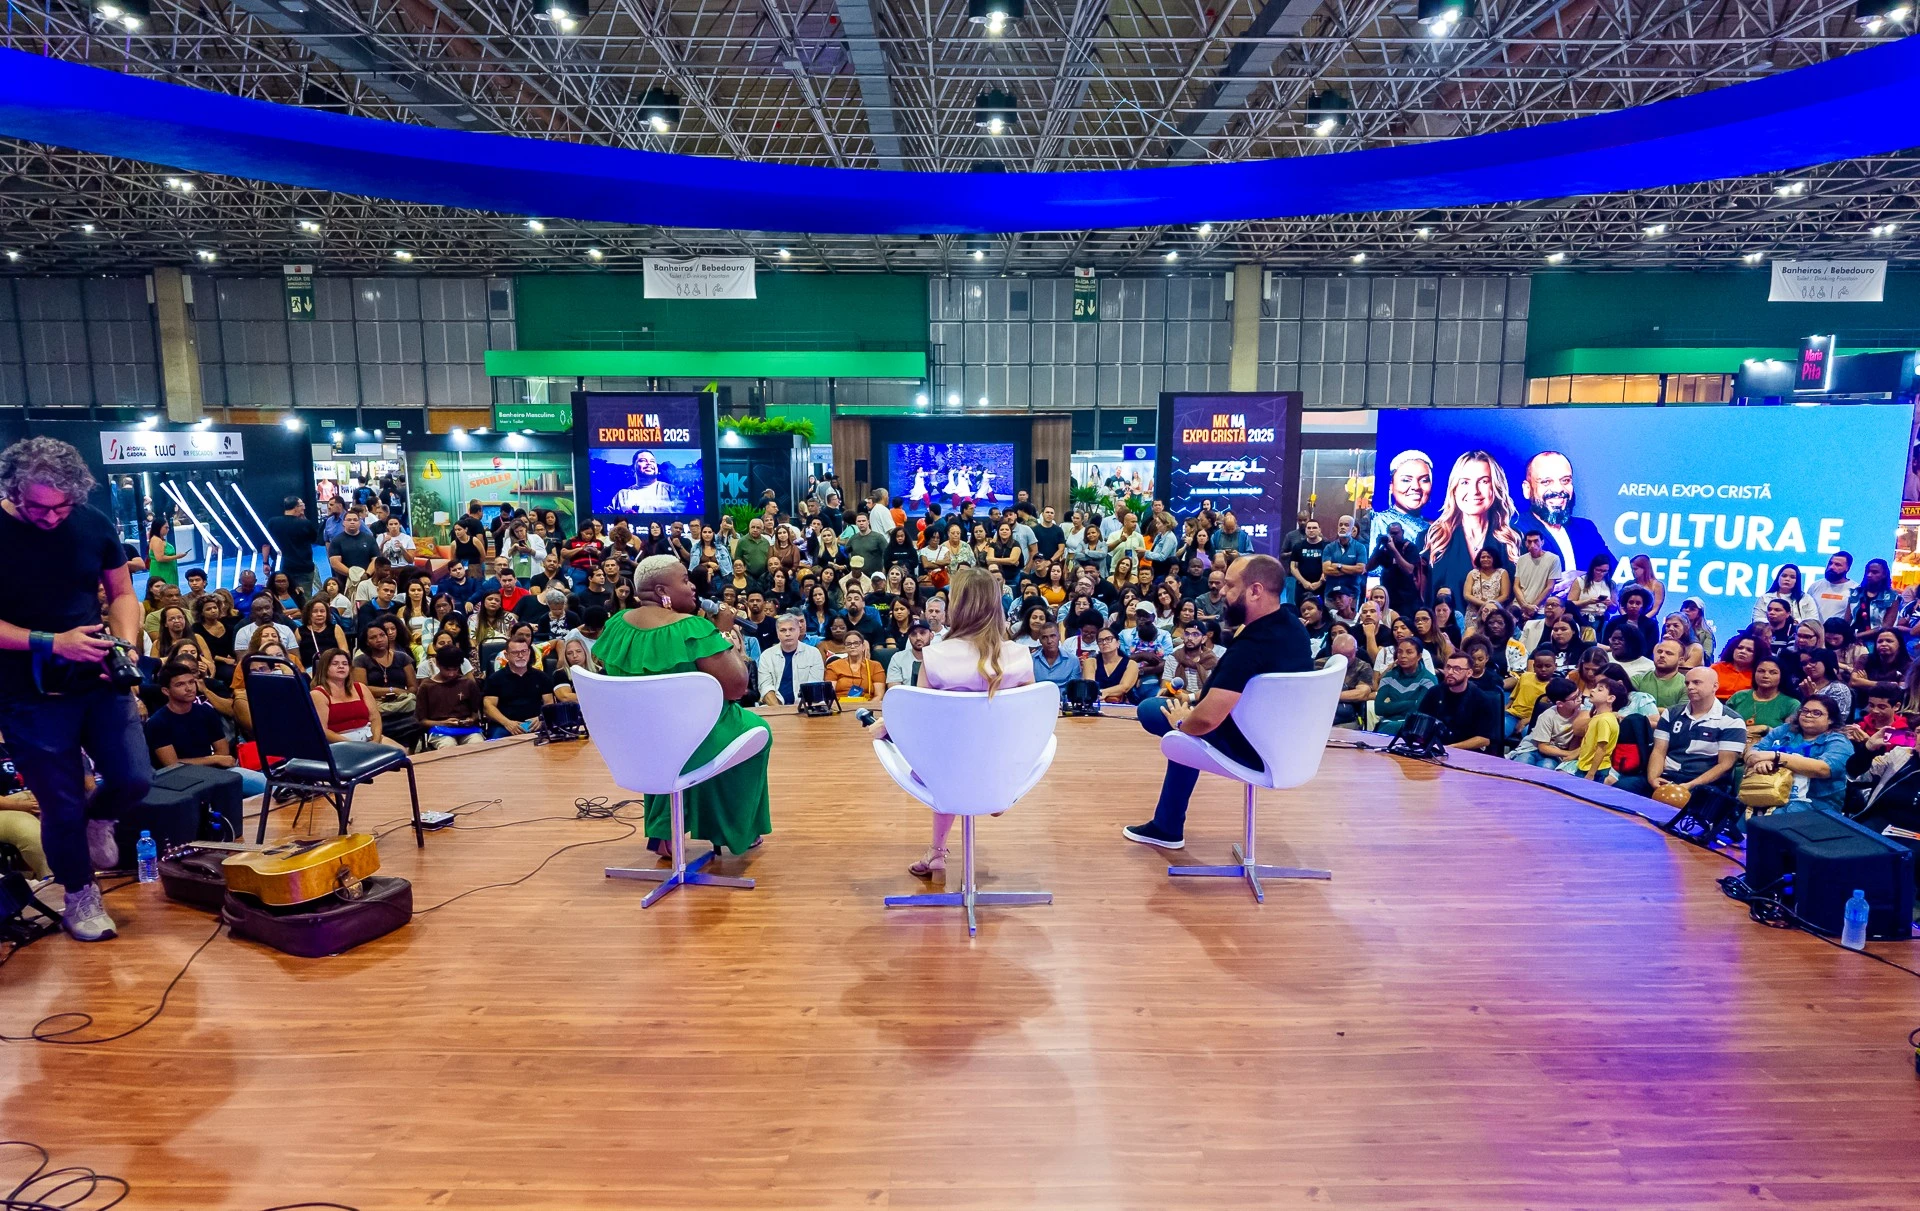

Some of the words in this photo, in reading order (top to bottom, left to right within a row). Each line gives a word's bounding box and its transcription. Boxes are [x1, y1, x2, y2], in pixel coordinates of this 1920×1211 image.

[654, 264, 693, 272] Banheiros
[1805, 349, 1822, 362] Maria
[1802, 362, 1822, 380] Pita
[628, 414, 644, 427] MK
[645, 414, 660, 427] NA
[1213, 414, 1230, 428] MK
[1230, 414, 1246, 428] NA
[599, 428, 625, 442] EXPO
[627, 426, 662, 442] CRISTÃ
[664, 428, 690, 442] 2025
[1183, 429, 1209, 442] EXPO
[1211, 427, 1246, 442] CRISTÃ
[1248, 428, 1274, 442] 2025
[470, 473, 512, 488] SPOILER
[720, 472, 748, 498] MK
[1618, 483, 1668, 497] ARENA
[1672, 484, 1714, 498] EXPO
[1717, 483, 1772, 499] CRISTÃ
[1614, 511, 1806, 553] CULTURA
[1817, 518, 1844, 554] E
[1673, 720, 1683, 733] 8
